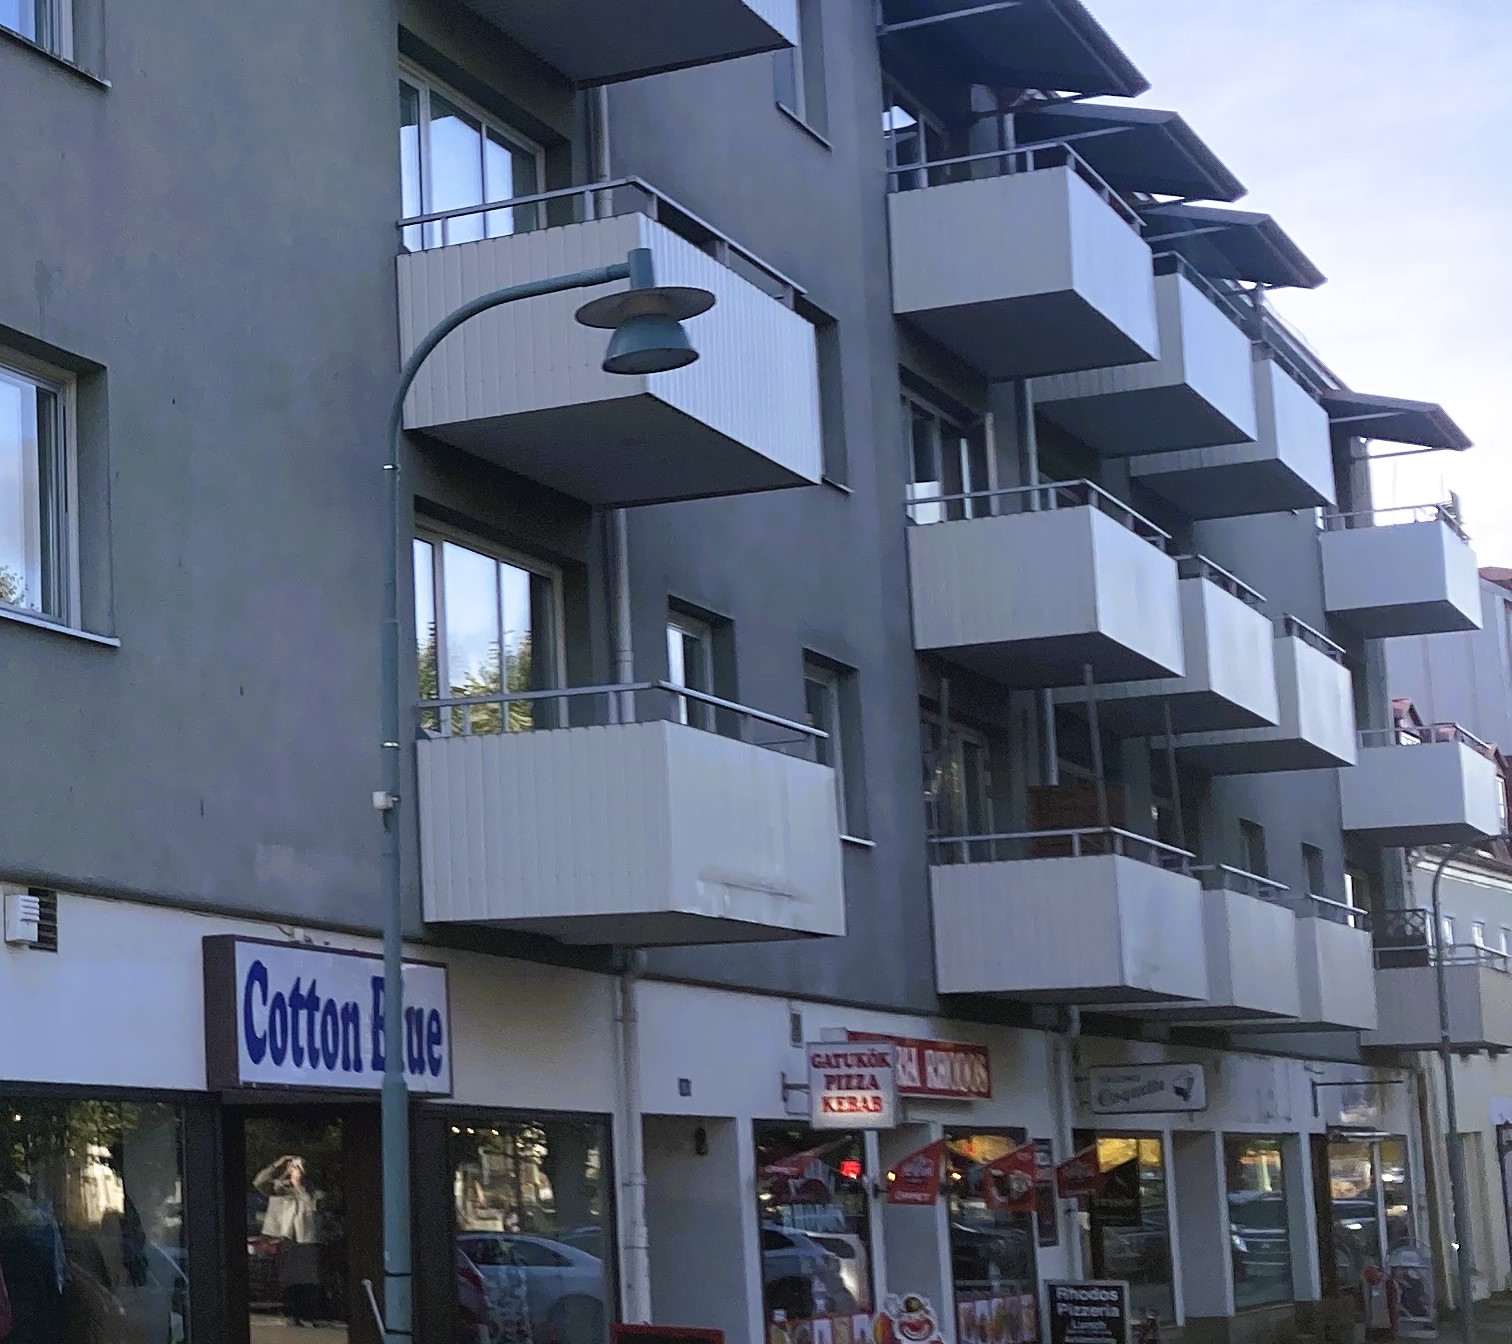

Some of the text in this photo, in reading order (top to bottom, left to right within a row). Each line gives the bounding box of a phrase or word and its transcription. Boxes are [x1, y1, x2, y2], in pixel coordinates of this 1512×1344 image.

[244, 959, 443, 1077] Cotton Bue
[824, 1074, 880, 1090] PIZZA
[822, 1096, 883, 1112] KEBAB
[1056, 1286, 1119, 1301] Rhodos
[1056, 1302, 1120, 1317] Pizzeria
